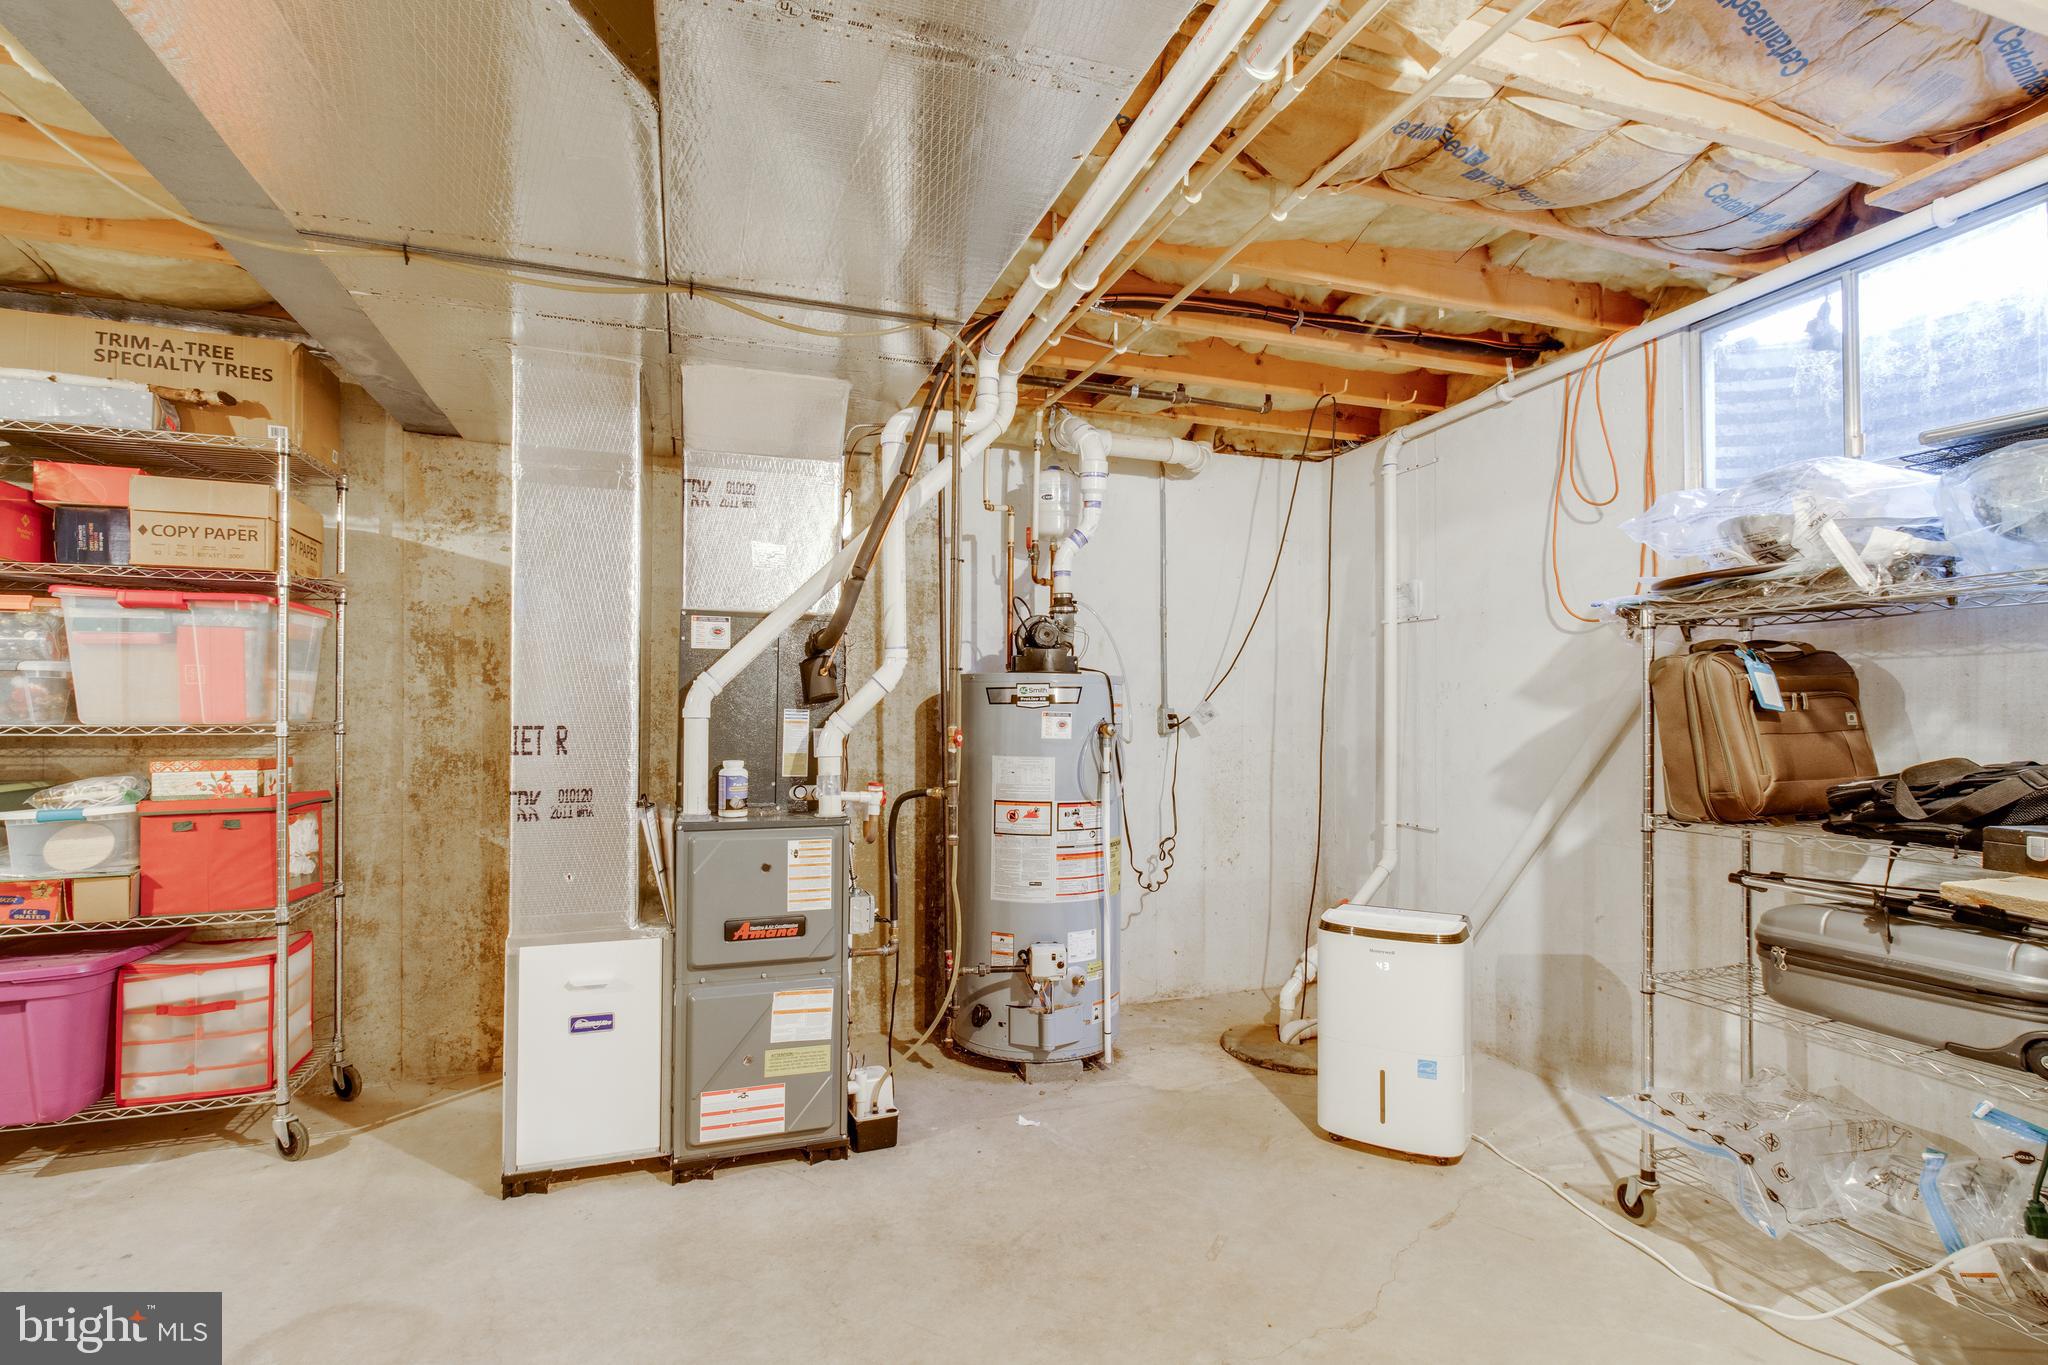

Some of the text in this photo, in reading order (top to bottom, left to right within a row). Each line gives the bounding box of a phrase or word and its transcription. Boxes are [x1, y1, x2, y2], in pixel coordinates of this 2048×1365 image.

[95, 331, 234, 360] TRIM-A-TREE
[94, 349, 273, 382] SPECIALTY TREES
[151, 524, 258, 542] COPY PAPER
[298, 541, 318, 563] PAPER
[1028, 686, 1048, 694] Smith
[556, 725, 568, 755] R
[733, 921, 799, 940] Amana
